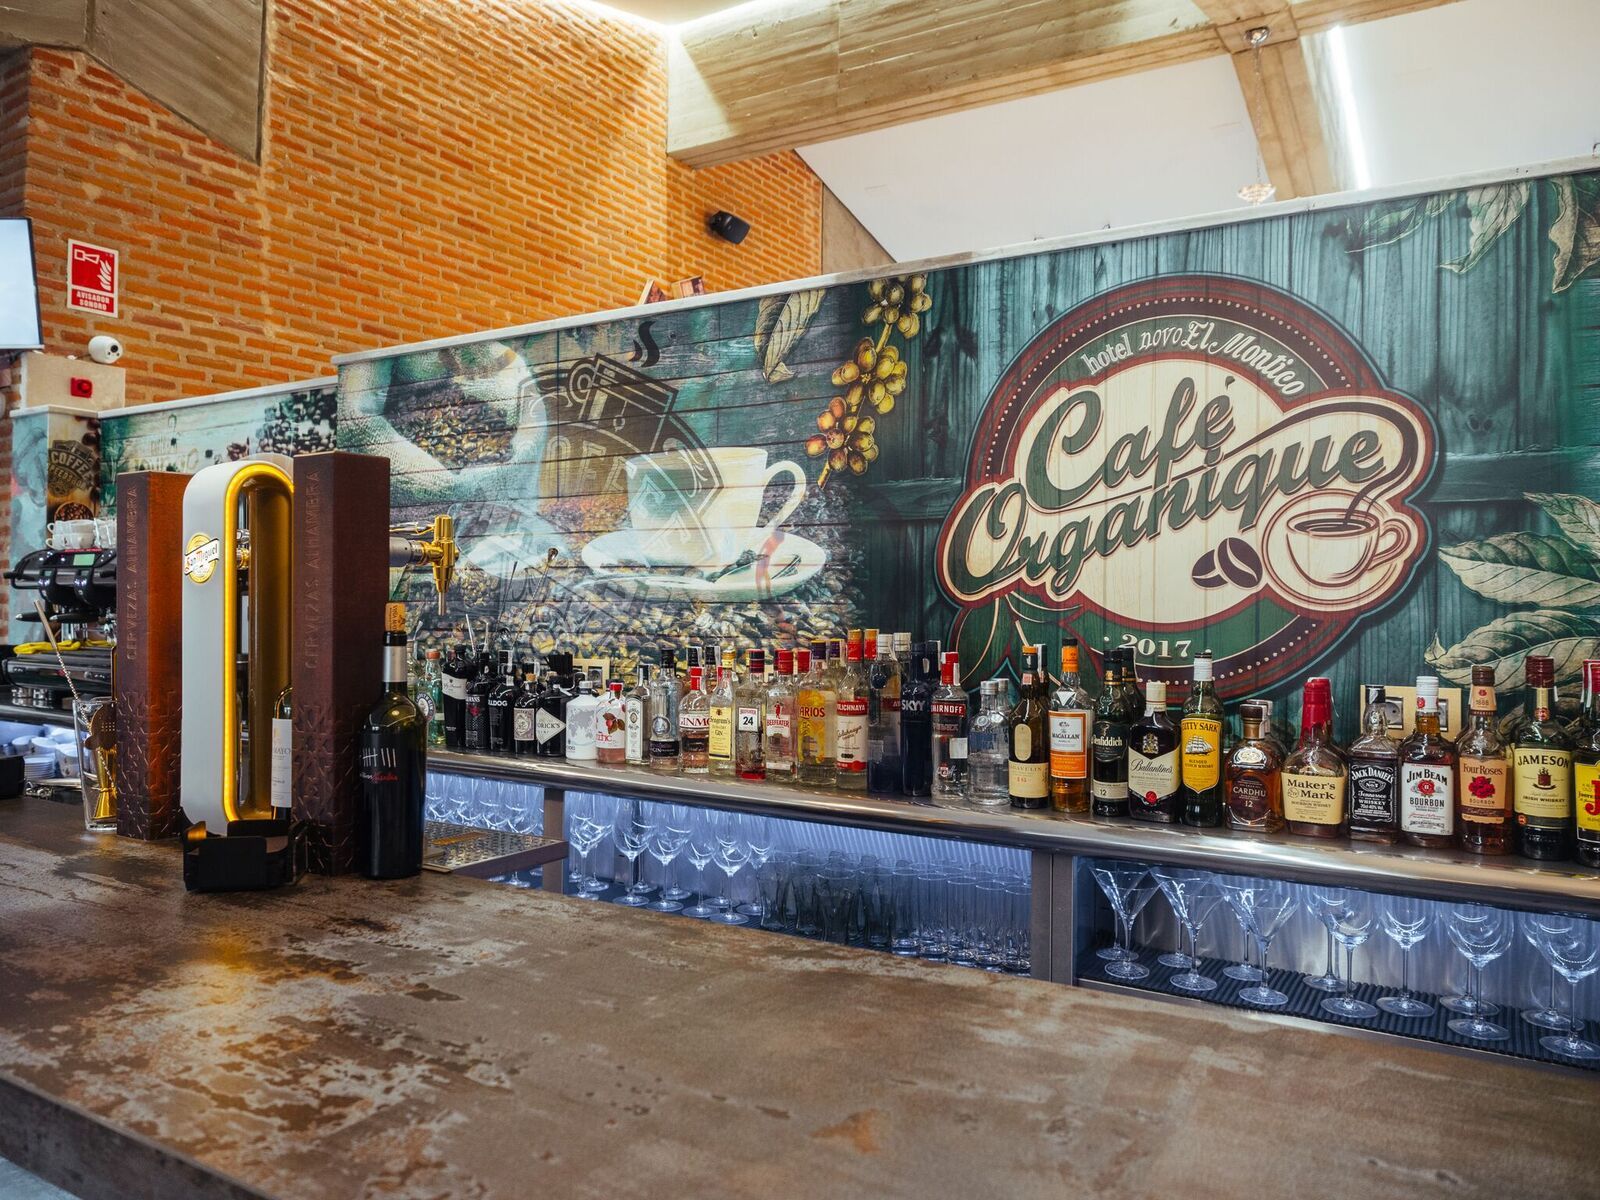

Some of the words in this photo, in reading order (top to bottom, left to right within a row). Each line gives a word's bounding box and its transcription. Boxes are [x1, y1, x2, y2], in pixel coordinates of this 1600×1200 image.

[76, 291, 110, 304] AVISADOR
[79, 299, 107, 311] SONORO
[1080, 334, 1134, 375] hotel
[1139, 326, 1181, 351] novo
[1180, 320, 1209, 350] El
[1208, 332, 1306, 396] Montico
[1025, 375, 1237, 511] Café
[50, 450, 93, 482] COFFEE
[948, 428, 1387, 596] Organique
[305, 470, 320, 570] ALHAMBRA
[126, 485, 138, 573] ALHAMBRA
[126, 581, 138, 661] CERVEZAS
[305, 578, 320, 670] CERVEZAS
[1117, 634, 1192, 658] 2017
[901, 700, 926, 711] SKYY
[743, 716, 754, 726] 24
[767, 719, 790, 728] BEEFEATER
[1199, 723, 1219, 733] SARK
[1131, 758, 1173, 774] Ballantine's
[1517, 754, 1570, 769] JAMESON
[1351, 769, 1368, 781] JACK
[1368, 767, 1394, 784] DANIEL'S
[1406, 770, 1423, 783] JIM
[1424, 768, 1448, 786] BEAM
[1463, 763, 1480, 775] Four
[1480, 765, 1503, 776] Roses
[1233, 786, 1267, 797] CARDHU
[1287, 778, 1336, 790] Maker's
[1357, 790, 1387, 799] Tennessee
[1244, 800, 1253, 808] 12
[1409, 797, 1445, 808] BOURBON
